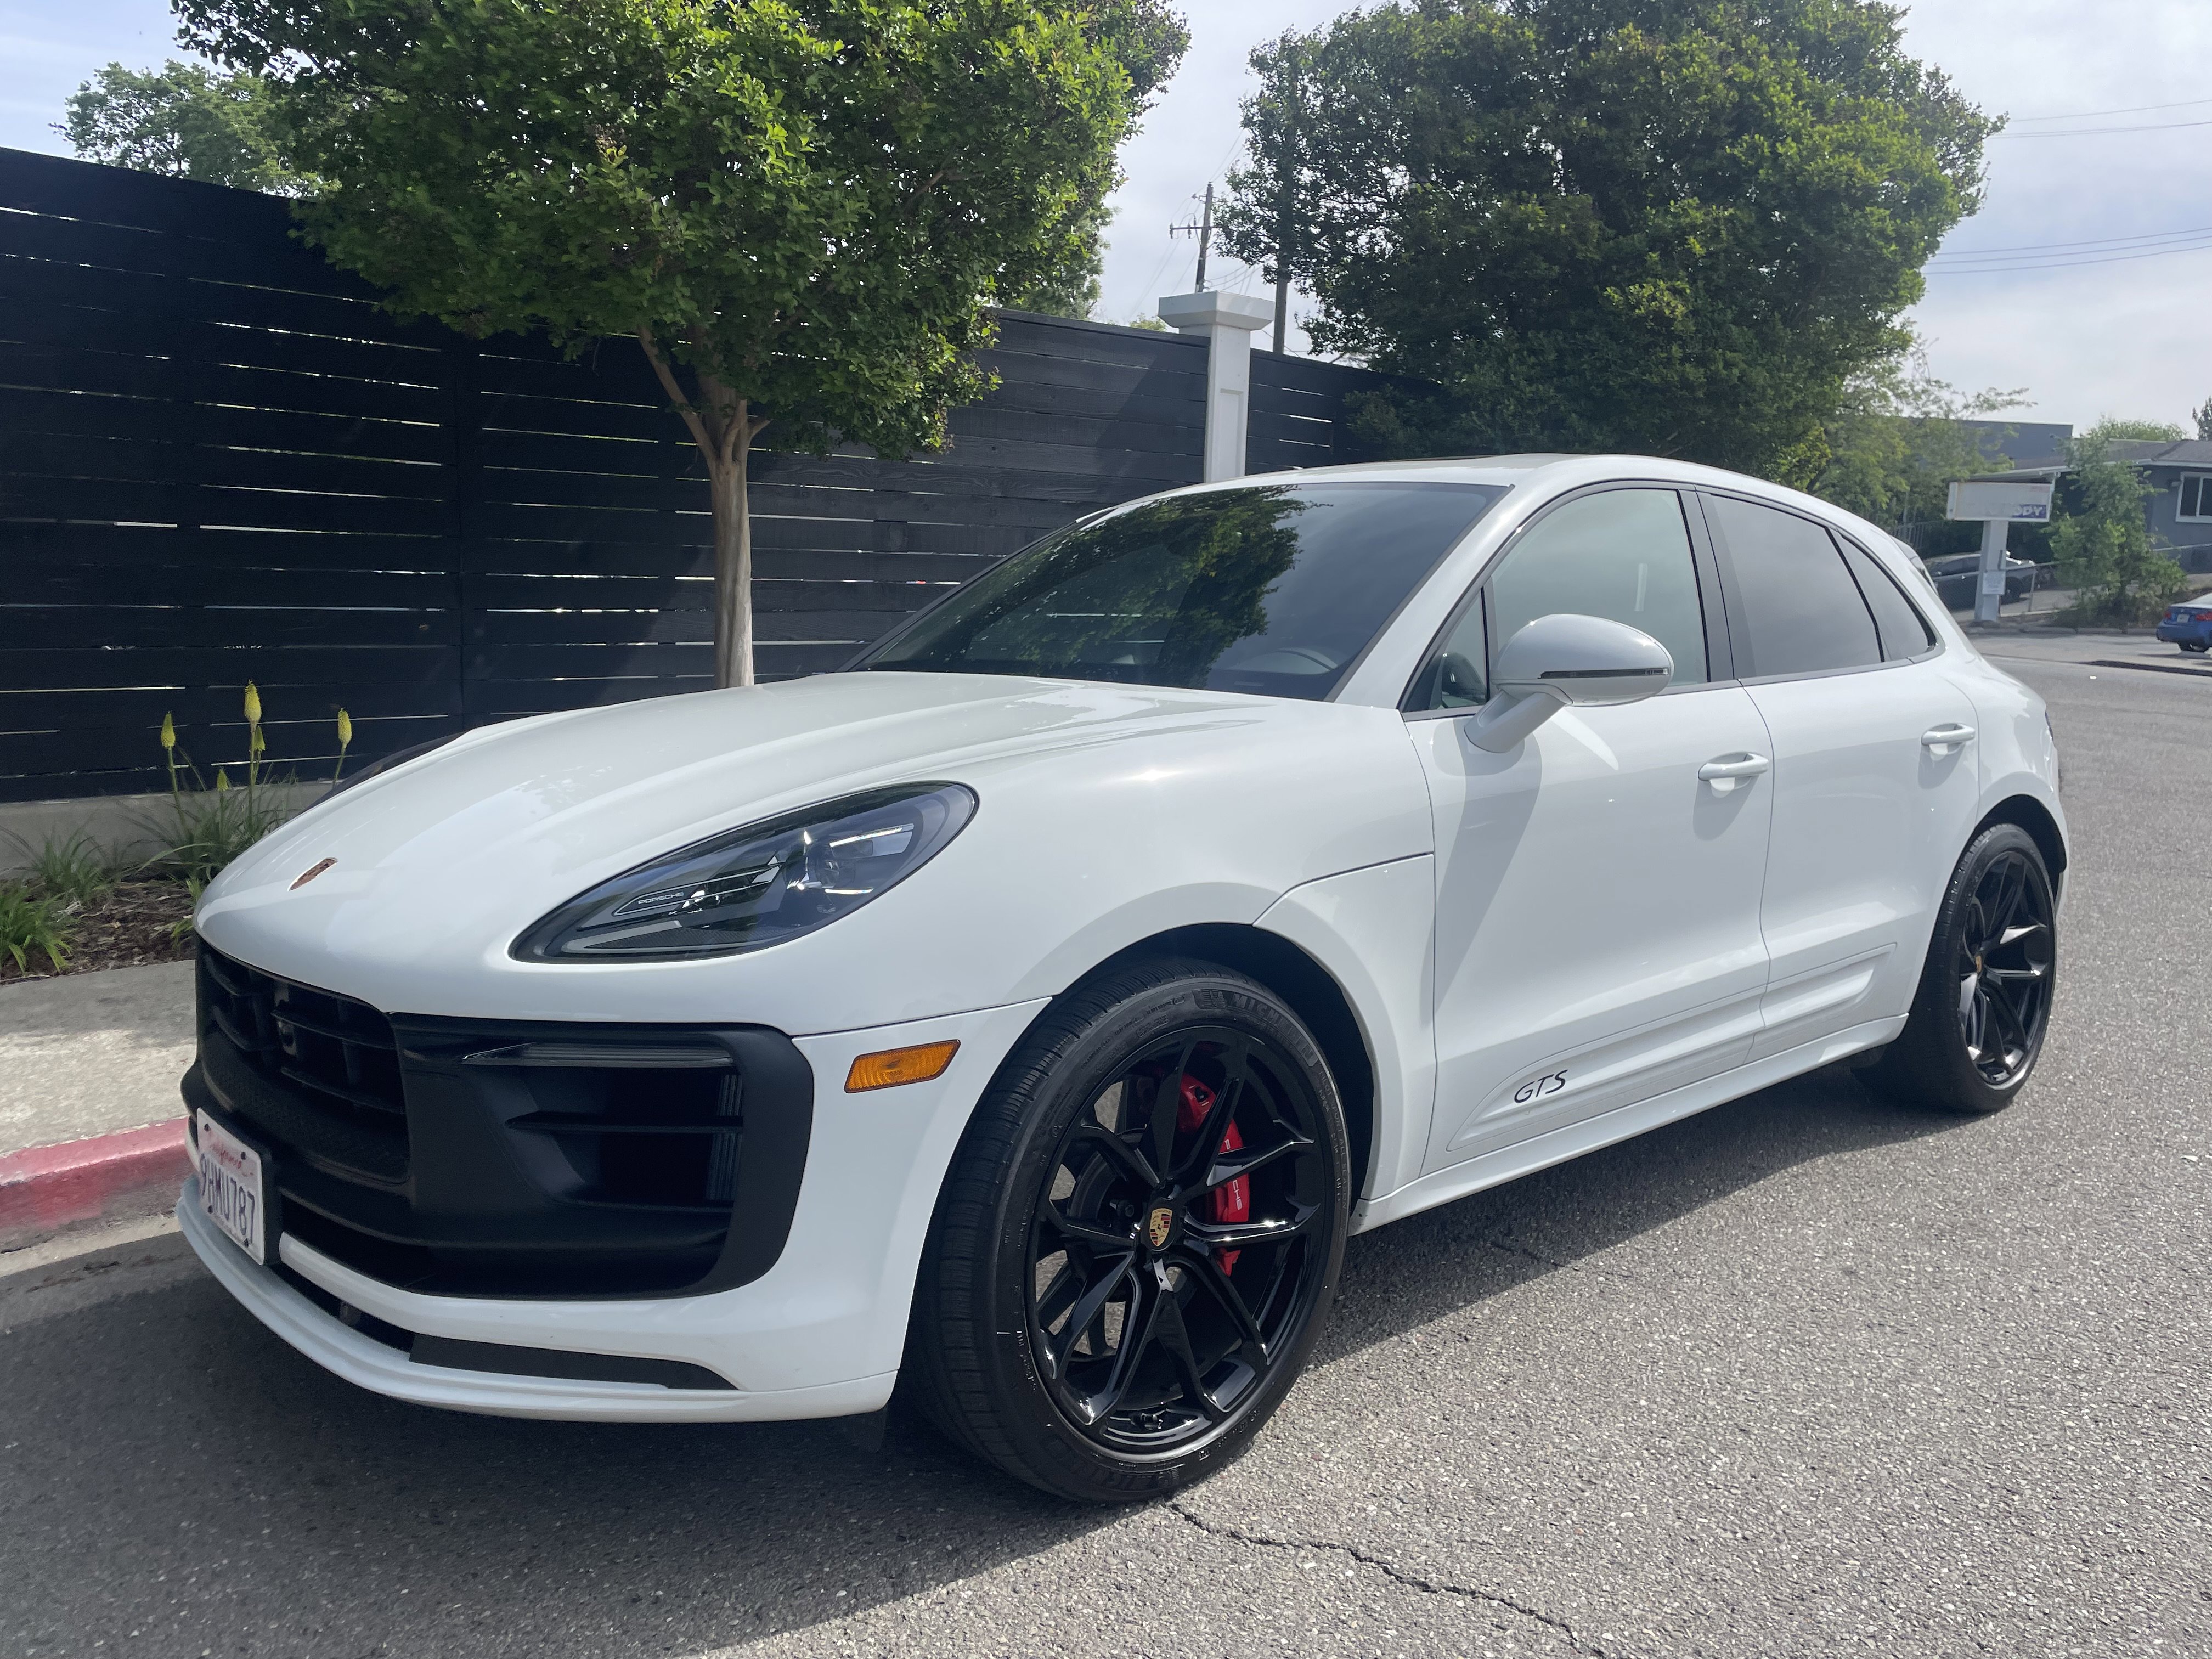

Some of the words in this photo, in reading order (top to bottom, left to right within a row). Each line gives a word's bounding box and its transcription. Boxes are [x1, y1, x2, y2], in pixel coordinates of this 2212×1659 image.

[638, 891, 684, 905] PORSCHE
[1514, 1069, 1568, 1103] GTS
[200, 1153, 255, 1245] 9HMU787
[1224, 1139, 1243, 1211] PCHE
